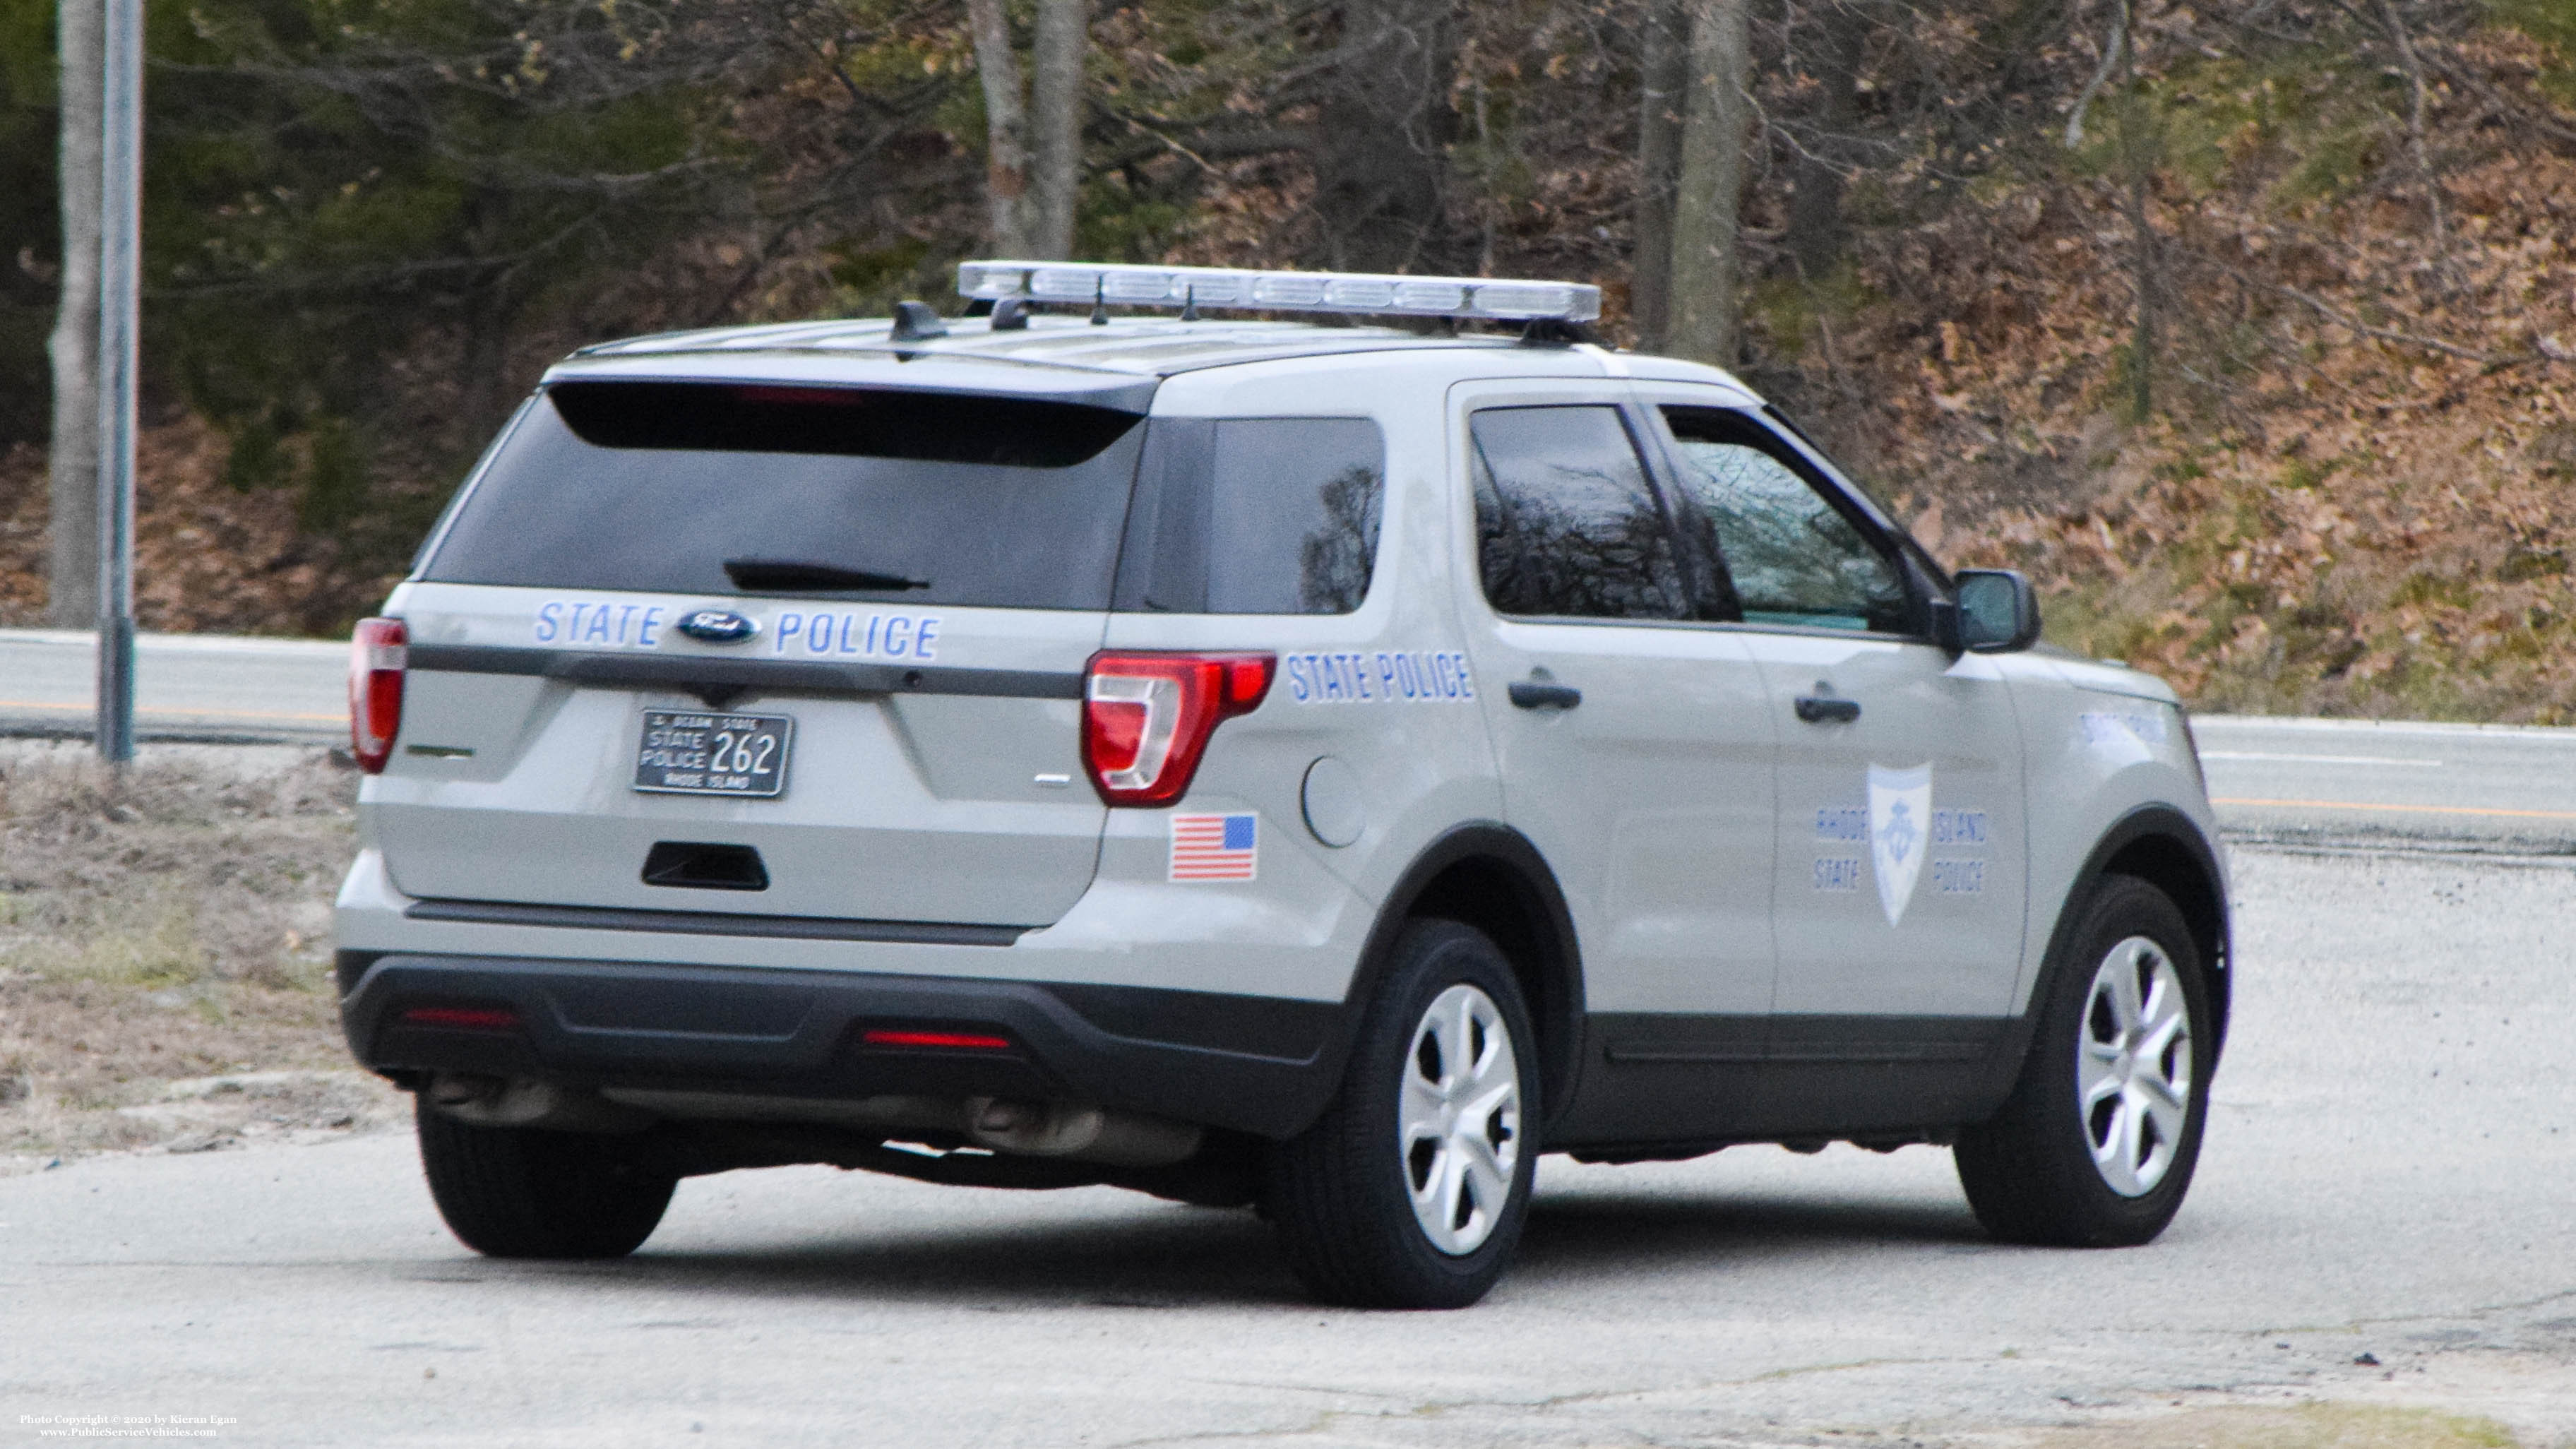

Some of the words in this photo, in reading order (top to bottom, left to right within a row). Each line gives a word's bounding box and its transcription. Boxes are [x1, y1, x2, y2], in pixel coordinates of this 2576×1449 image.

[535, 602, 664, 645] STATE
[777, 613, 941, 657] POLICE
[1287, 654, 1372, 700] STATE
[1377, 654, 1474, 699] POLICE
[649, 732, 705, 750] STATE
[710, 731, 776, 775] 262
[640, 749, 706, 769] POLICE
[664, 773, 704, 787] RHODE
[708, 776, 750, 789] ISLAND
[1816, 809, 1868, 840] RHODE
[1932, 811, 1986, 842] ISLAND
[1814, 859, 1858, 889] STATE
[1934, 861, 1984, 892] POLICE
